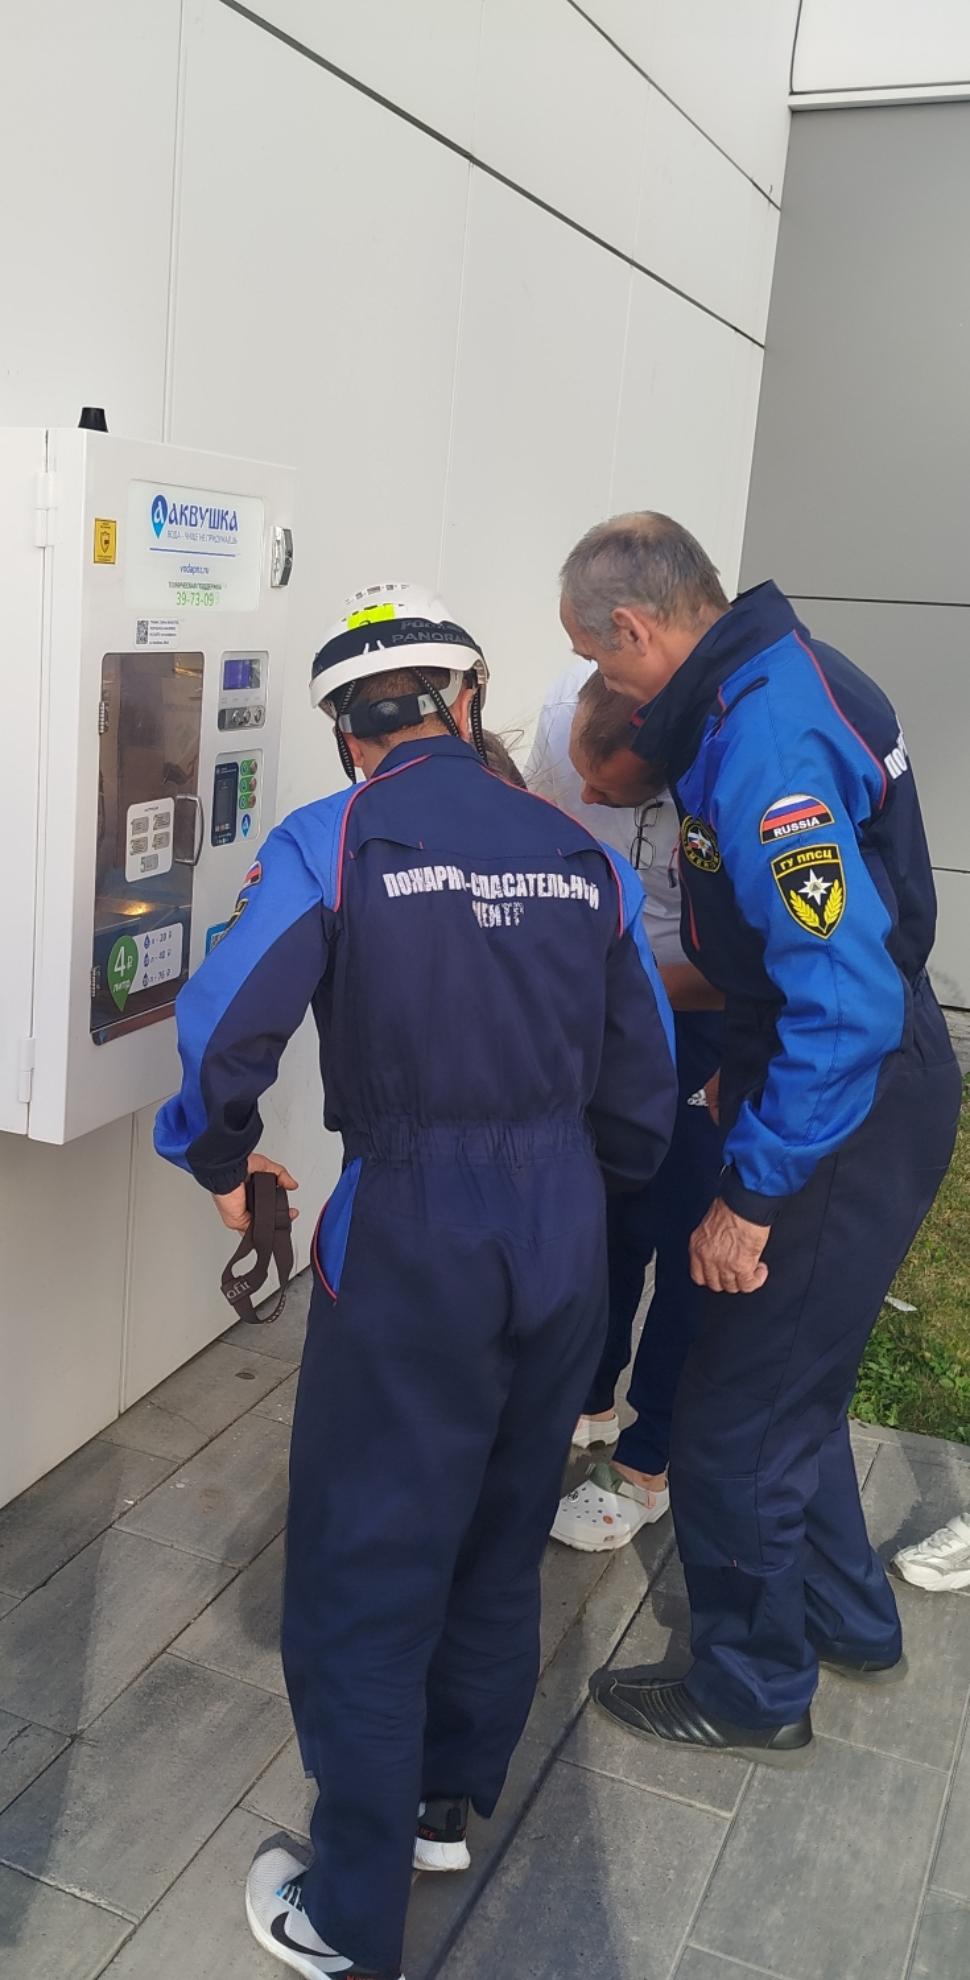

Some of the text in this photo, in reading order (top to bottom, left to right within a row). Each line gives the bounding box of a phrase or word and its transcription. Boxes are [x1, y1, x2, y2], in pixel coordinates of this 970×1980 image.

[168, 503, 238, 531] АКВУШКА
[176, 592, 214, 606] 39-73-09
[392, 631, 470, 643] PANORA
[773, 816, 820, 838] RUSSIA
[780, 849, 832, 870] ГУ ППСЦ
